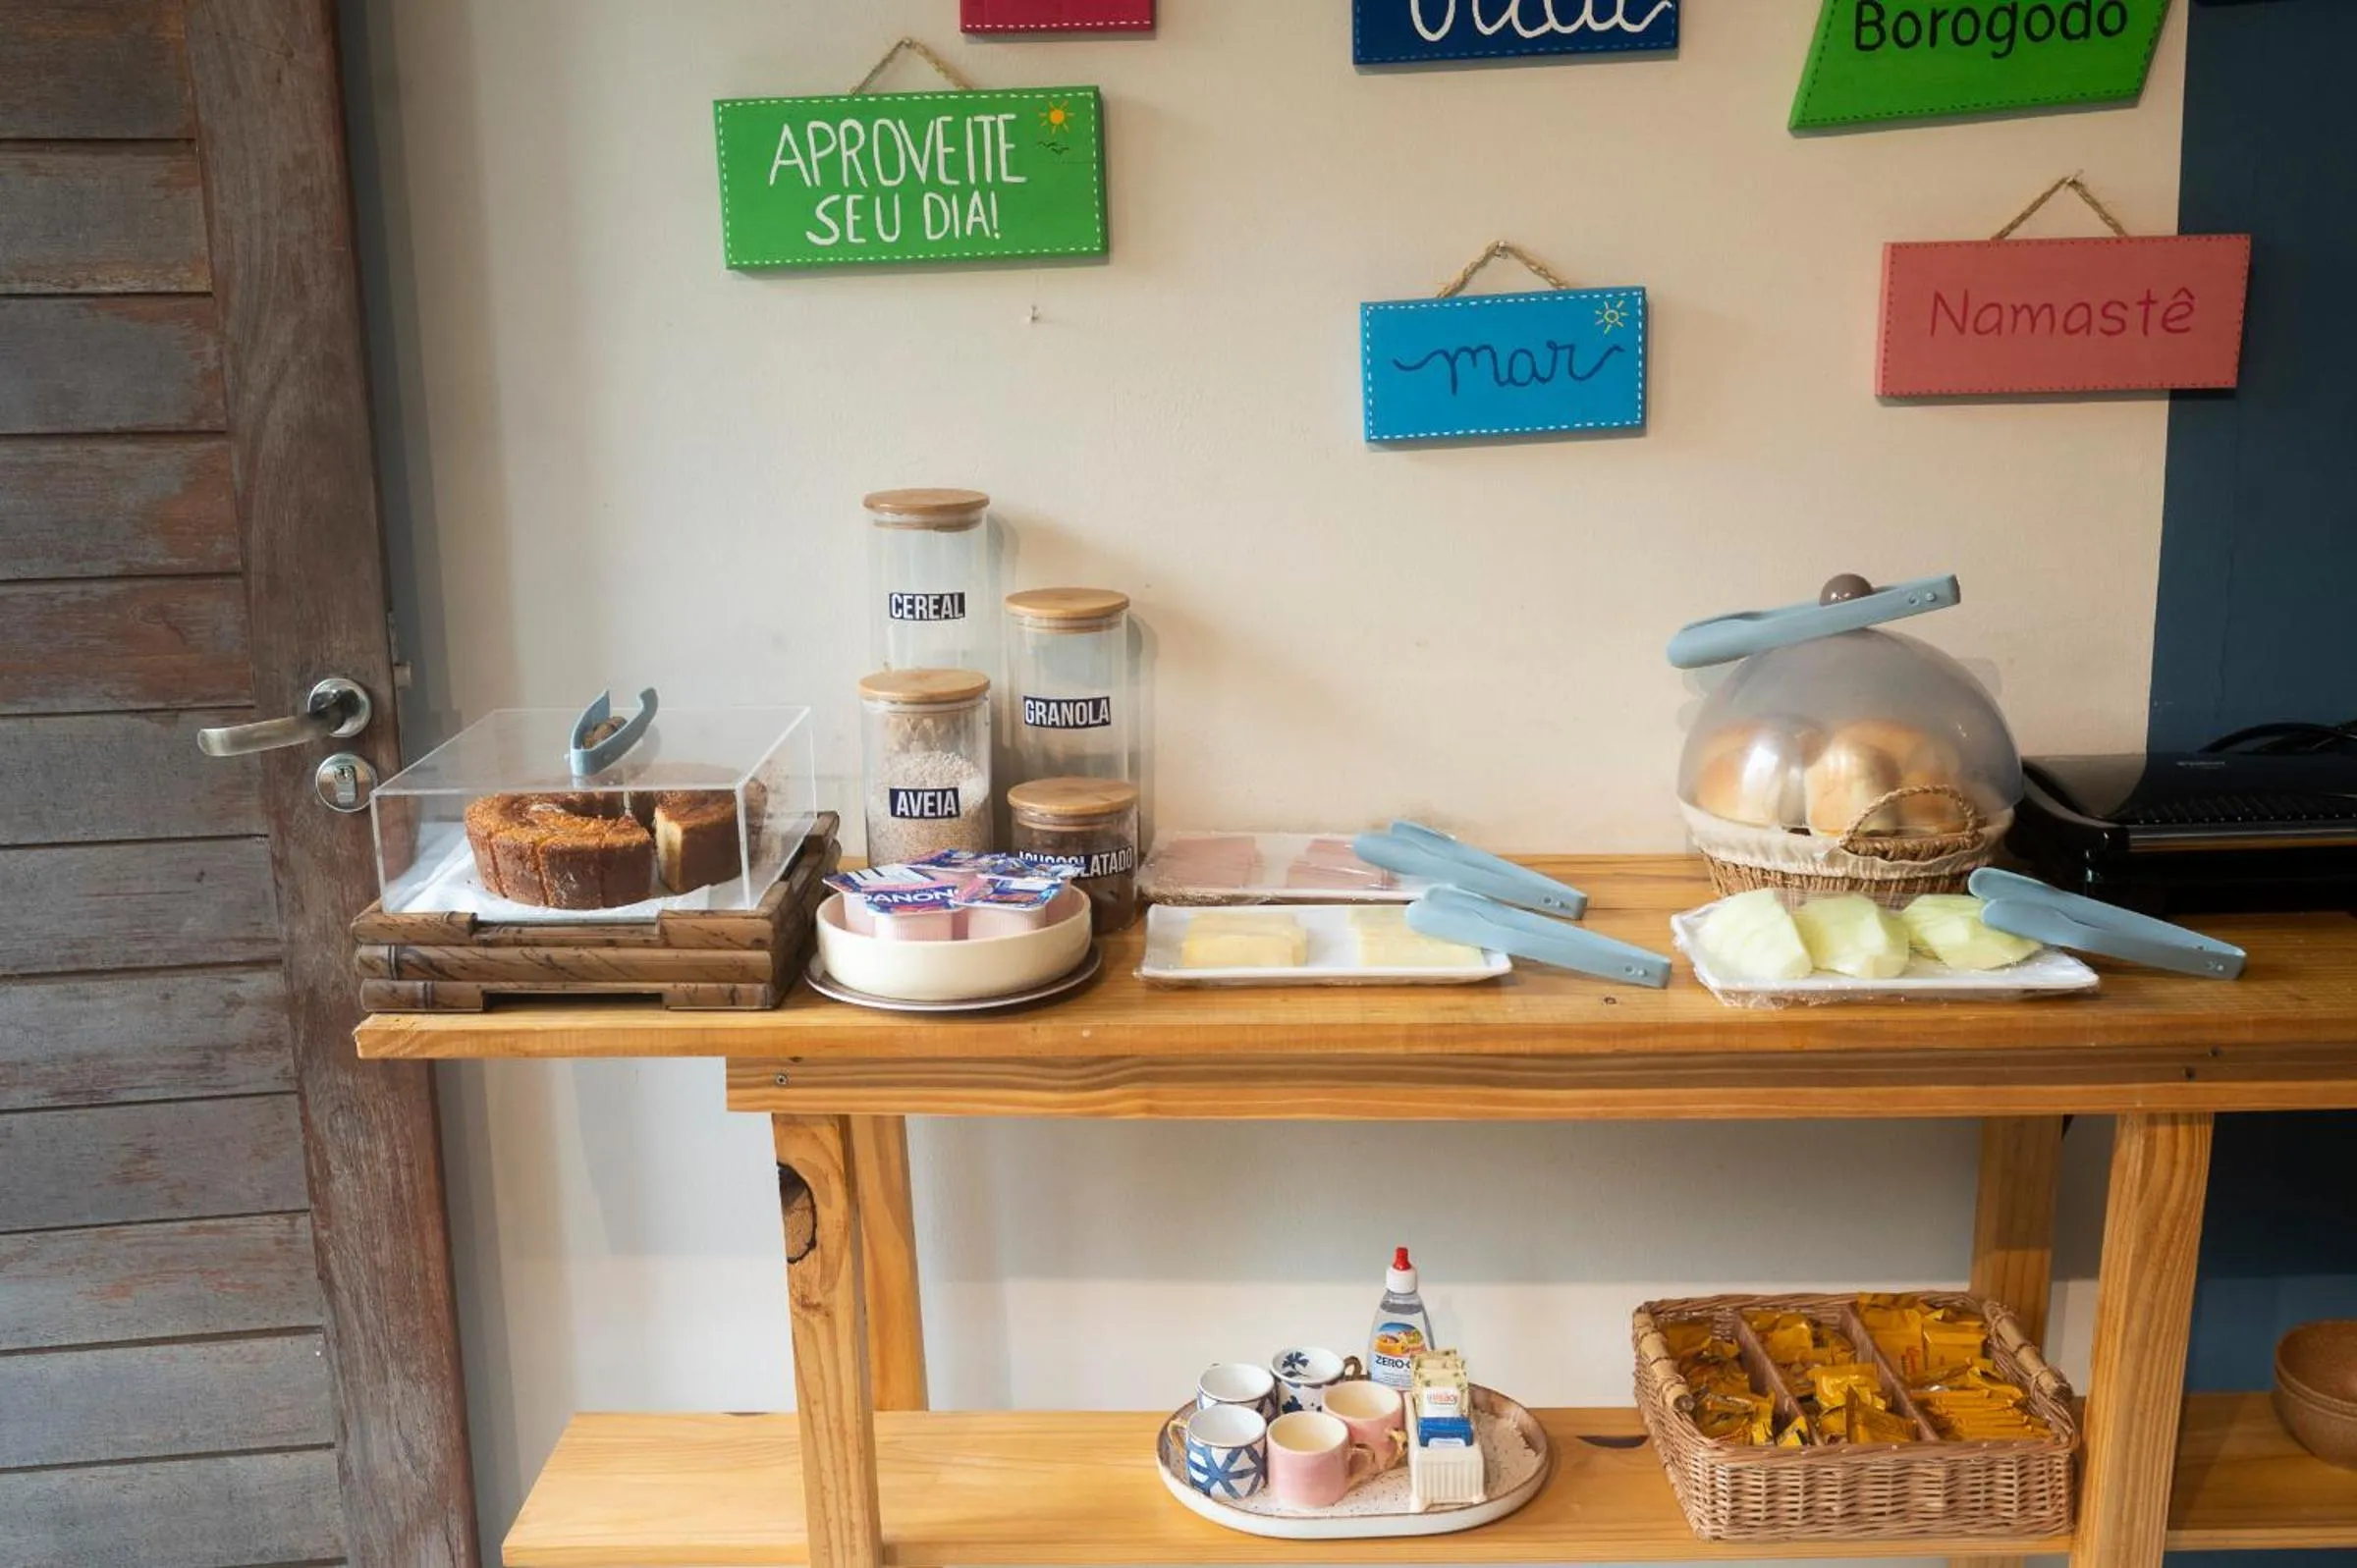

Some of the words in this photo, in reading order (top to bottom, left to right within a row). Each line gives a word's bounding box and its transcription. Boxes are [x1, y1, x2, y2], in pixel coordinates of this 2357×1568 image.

[769, 113, 1027, 188] APROVEITE
[805, 192, 901, 245] SEU
[923, 190, 1002, 241] DIA!
[1930, 287, 2196, 338] Namastê
[1392, 340, 1625, 397] mar
[890, 593, 965, 620] CEREAL
[1023, 697, 1111, 727] GRANOLA
[896, 789, 959, 817] AVEIA
[1018, 846, 1133, 878] LATADO
